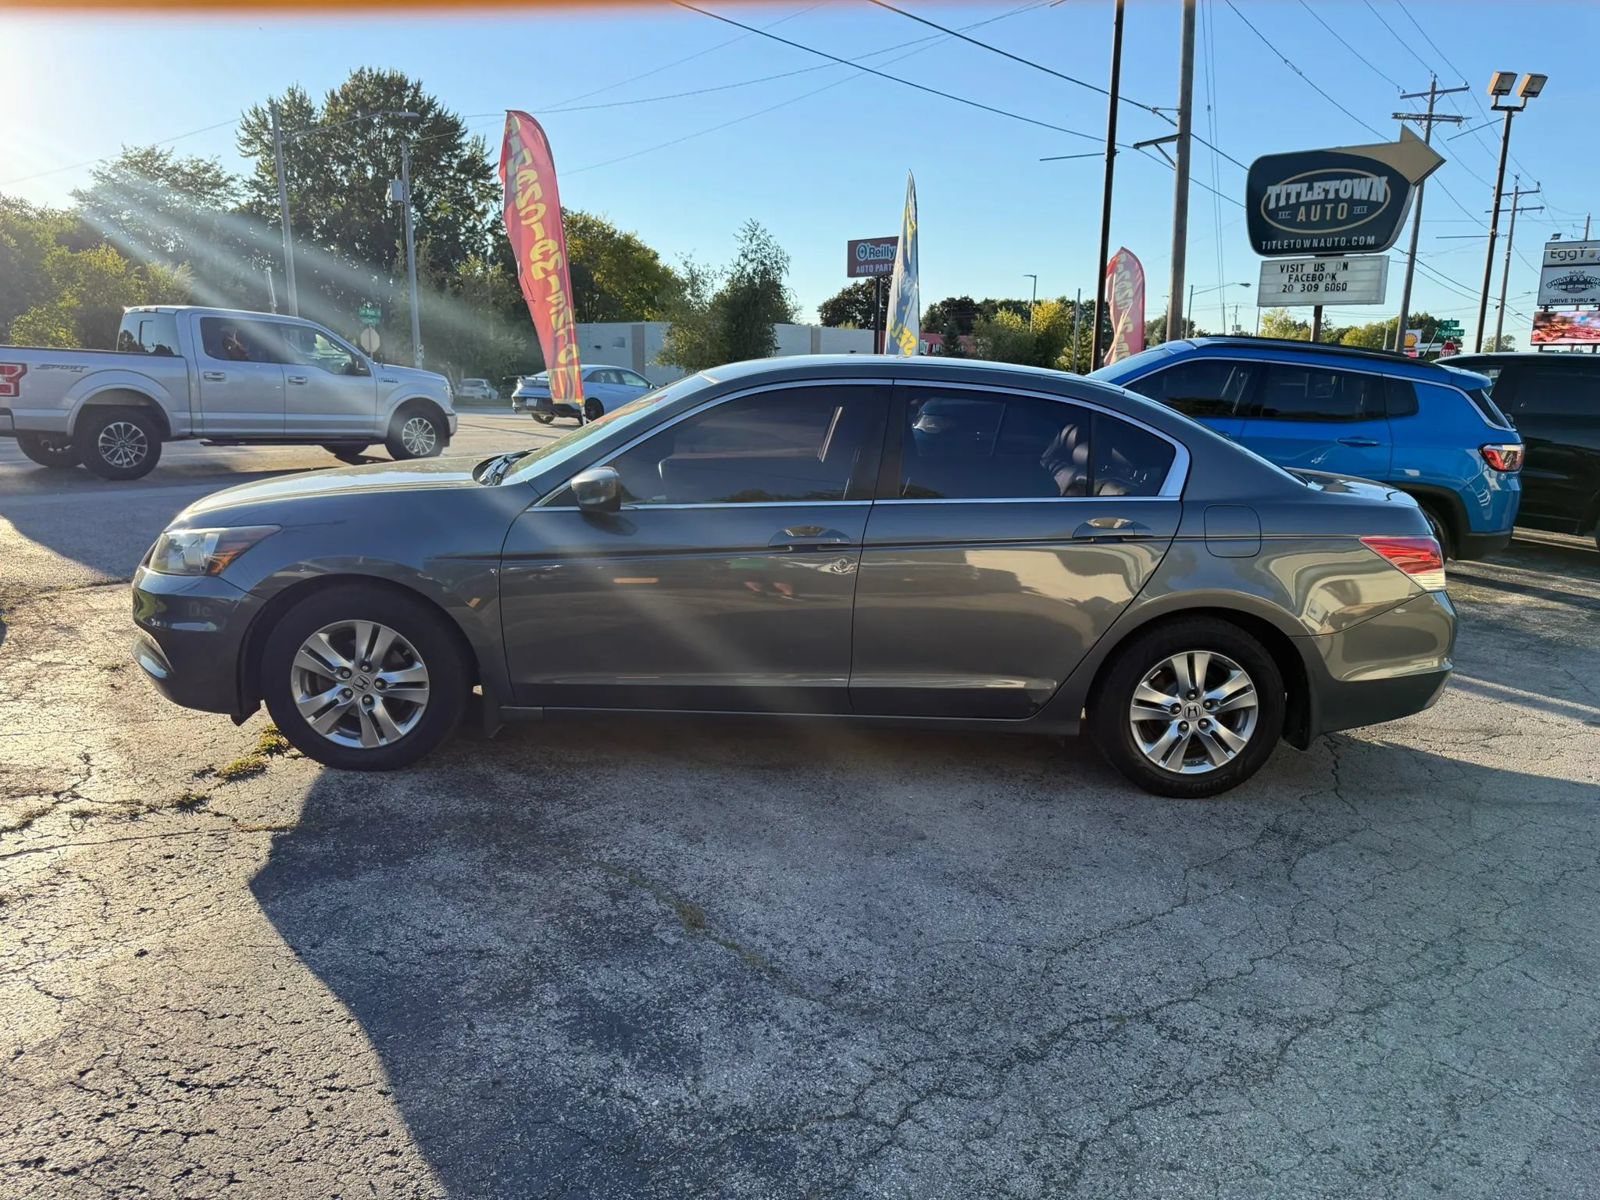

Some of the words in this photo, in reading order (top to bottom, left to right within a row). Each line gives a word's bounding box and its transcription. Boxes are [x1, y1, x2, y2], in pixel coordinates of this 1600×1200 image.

[1267, 176, 1388, 210] TITLETOWN
[1296, 202, 1348, 222] AUTO
[1262, 235, 1376, 250] TITLETOWNAUTO.COM
[856, 242, 897, 261] O'Reilly
[856, 264, 874, 273] AUTO
[875, 263, 895, 272] PART
[1280, 263, 1305, 273] VISIT
[1313, 262, 1326, 272] US
[1300, 283, 1319, 292] 309
[1324, 282, 1348, 292] 6060
